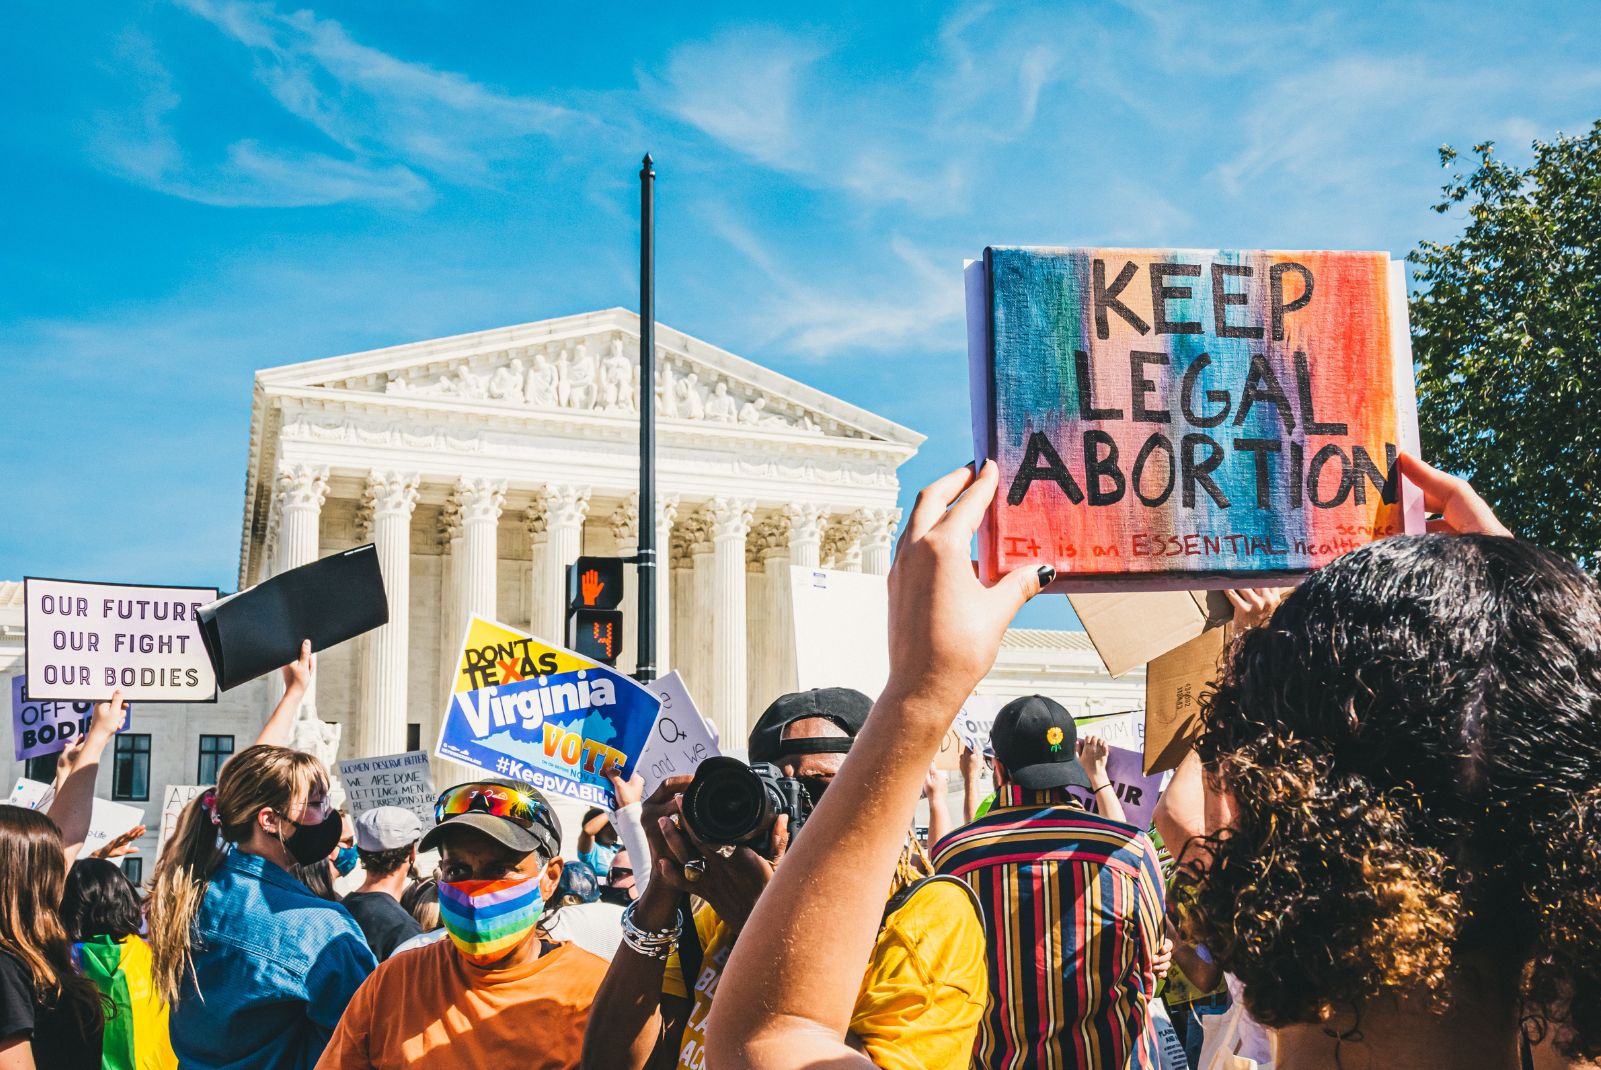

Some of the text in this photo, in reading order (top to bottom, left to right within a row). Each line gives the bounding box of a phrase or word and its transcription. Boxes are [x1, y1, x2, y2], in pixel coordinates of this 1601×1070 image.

[1092, 259, 1315, 341] KEEP
[1075, 350, 1348, 436] LEGAL
[1006, 431, 1398, 511] ABORTION
[1004, 536, 1041, 558] It
[1058, 536, 1078, 558] is
[1092, 544, 1120, 558] an
[1131, 532, 1288, 558] ESSENTIAL
[41, 594, 202, 622] OUR FUTURE
[53, 630, 190, 654] OUR FIGHT
[464, 637, 533, 667] DON'T
[592, 621, 613, 658] 4
[43, 664, 199, 687] OUR BODIES
[462, 652, 558, 691] TEXAS
[21, 701, 66, 726] OFF
[453, 669, 617, 739] Virginia
[542, 721, 628, 779] VOTE
[341, 763, 370, 775] WOMEN
[570, 768, 590, 782] NOV
[651, 752, 677, 779] and
[346, 777, 364, 788] WE
[393, 771, 422, 785] DONE
[401, 784, 425, 795] MEN
